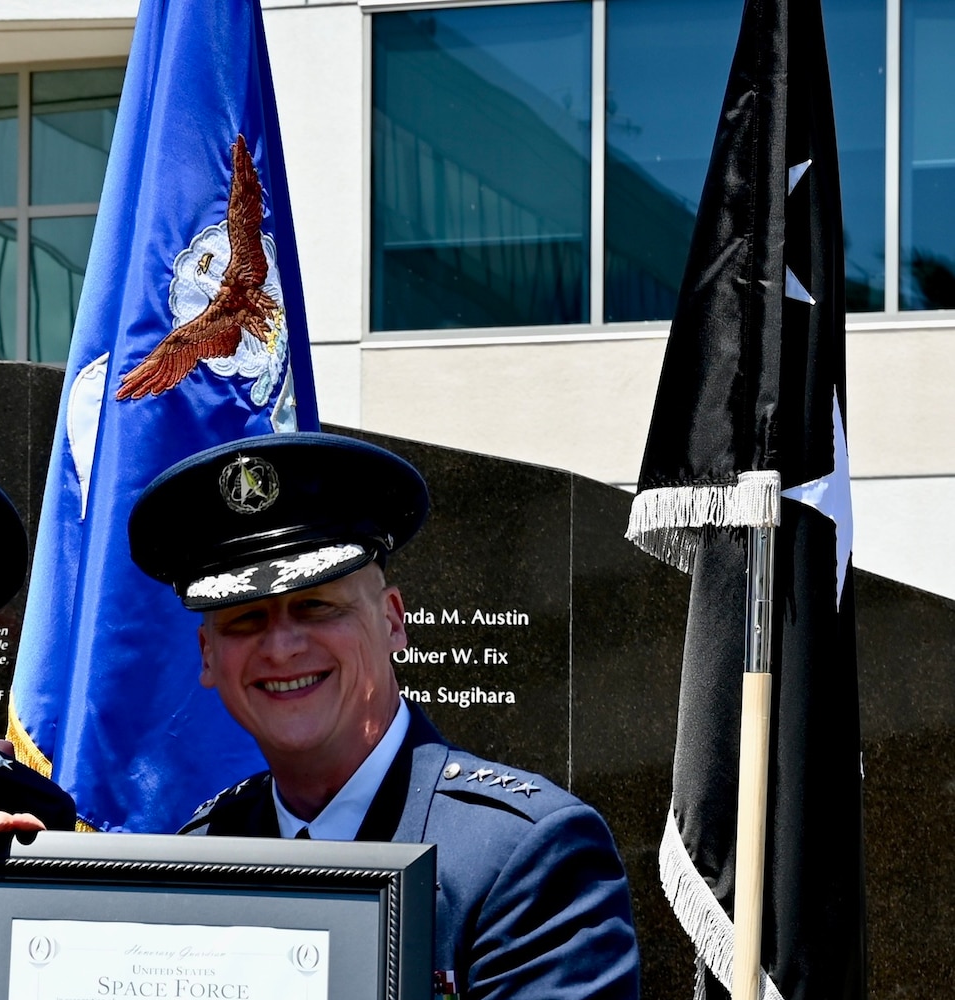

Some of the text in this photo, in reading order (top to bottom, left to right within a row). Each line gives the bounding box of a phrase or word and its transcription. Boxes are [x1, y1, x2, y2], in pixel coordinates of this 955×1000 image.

[441, 608, 466, 626] M.
[471, 609, 530, 626] Austin
[392, 648, 509, 665] Oliver W. Fix
[437, 686, 516, 708] Sugihara
